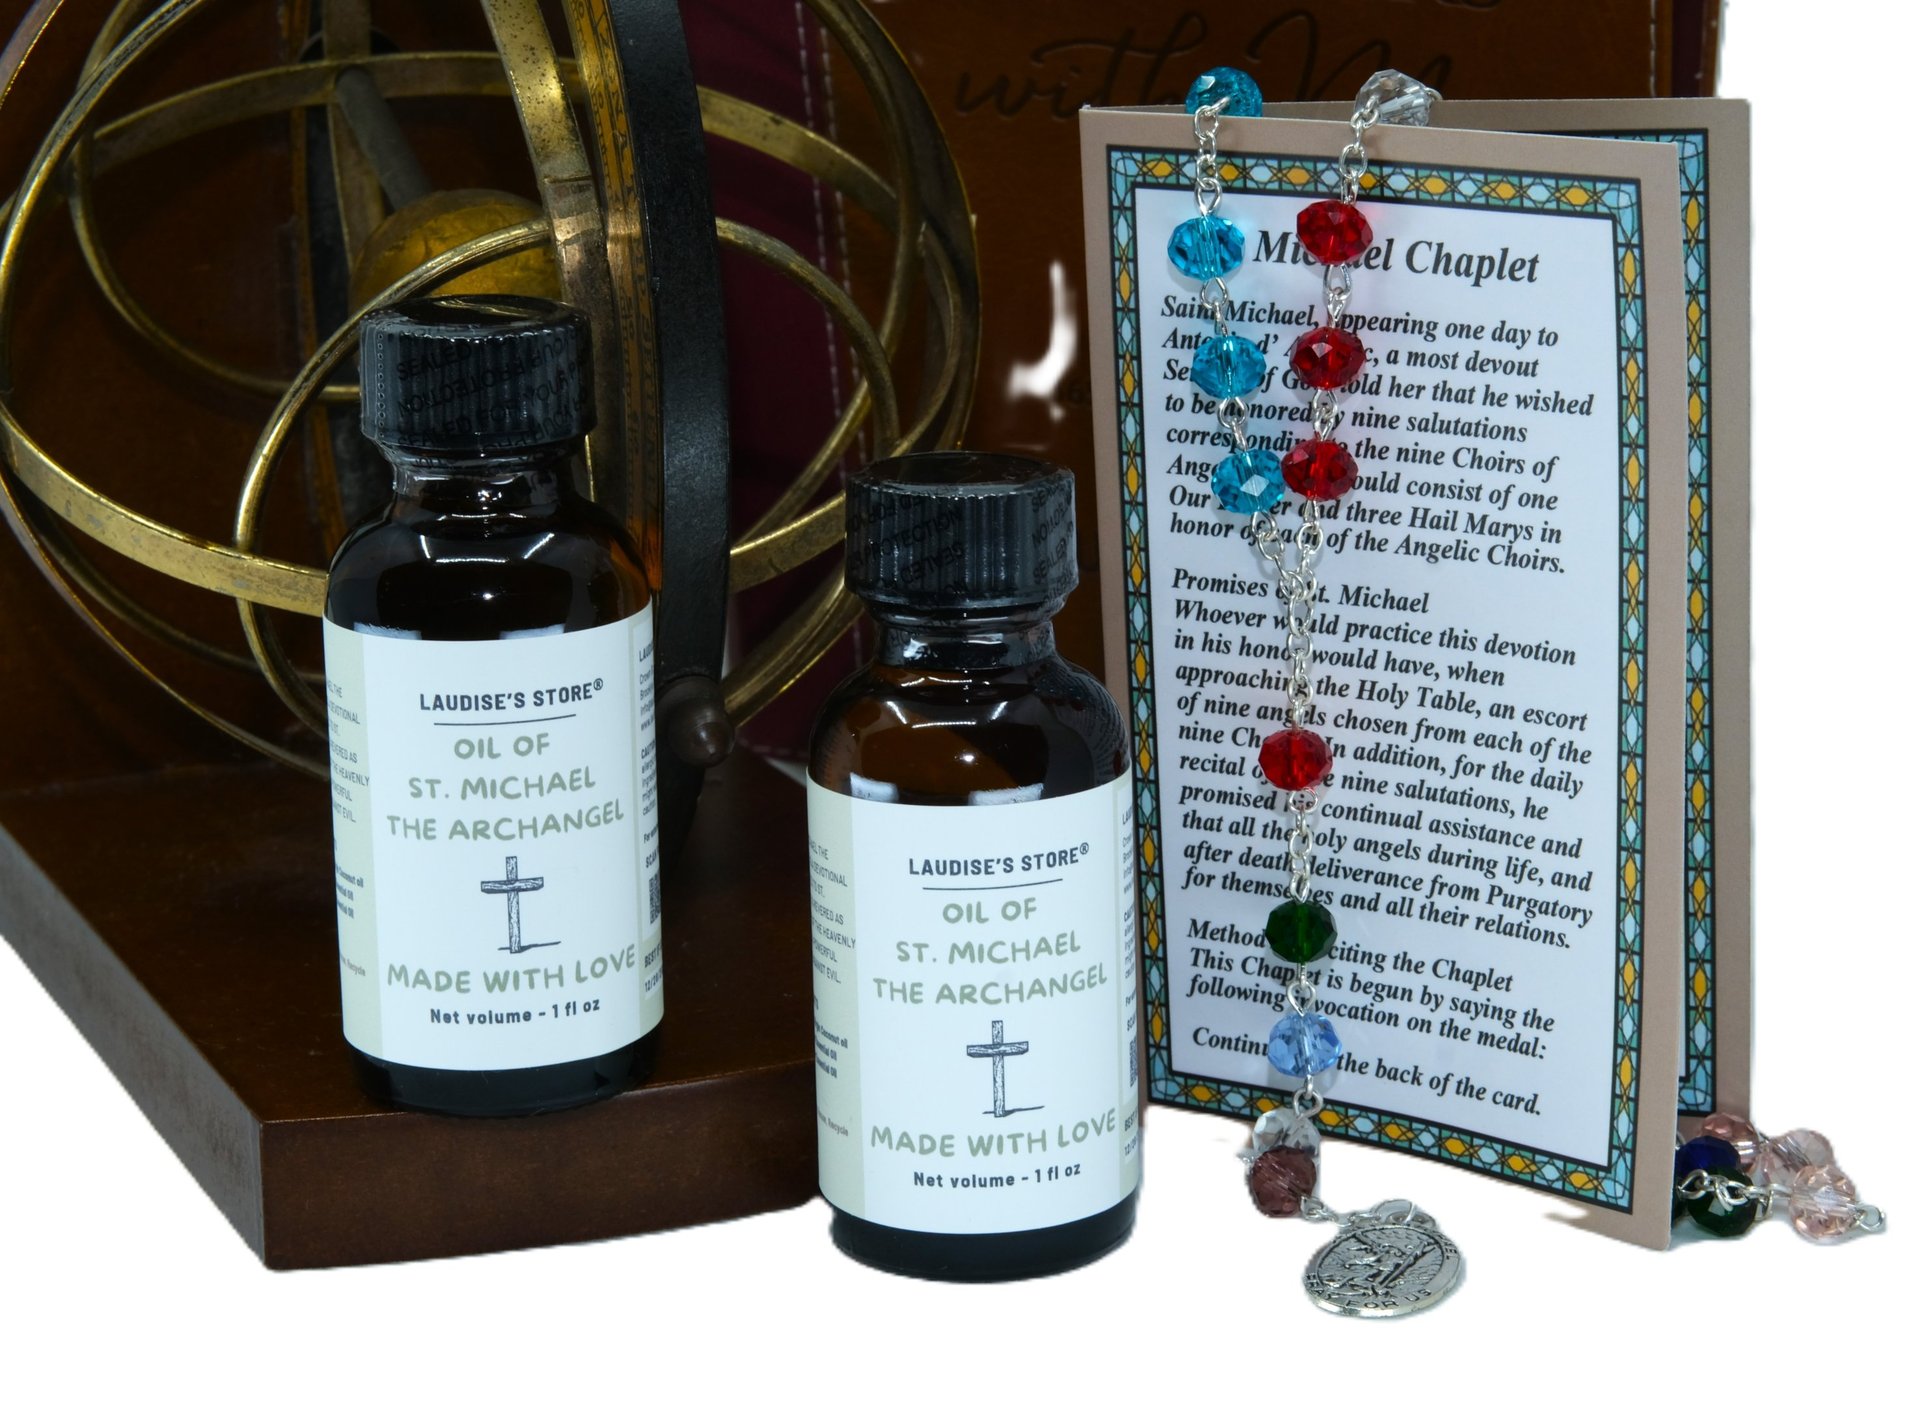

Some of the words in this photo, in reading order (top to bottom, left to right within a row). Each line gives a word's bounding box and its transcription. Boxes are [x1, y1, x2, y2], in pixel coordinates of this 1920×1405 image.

[1406, 241, 1539, 287] Chaplet
[1224, 301, 1319, 329] Michael,
[1445, 323, 1485, 340] one
[1491, 320, 1531, 350] day
[1538, 327, 1558, 346] to
[1386, 350, 1399, 364] a
[1407, 351, 1459, 370] most
[1465, 350, 1539, 377] devout
[1165, 394, 1184, 412] to
[1191, 392, 1217, 415] be
[1351, 406, 1400, 429] nine
[1406, 412, 1527, 442] salutations
[1388, 376, 1426, 399] her
[1432, 380, 1476, 404] that
[1482, 384, 1508, 407] he
[1515, 389, 1594, 416] wished
[1355, 438, 1389, 460] the
[1396, 442, 1445, 465] nine
[1453, 447, 1525, 474] Choirs
[1533, 456, 1559, 483] of
[1169, 485, 1211, 508] Our
[1346, 501, 1402, 525] three
[1408, 507, 1458, 531] Hail
[1463, 512, 1533, 544] Marys
[1541, 521, 1561, 543] in
[1406, 479, 1482, 502] consist
[1489, 484, 1516, 511] of
[1518, 493, 1558, 510] one
[1170, 512, 1234, 538] honor
[1327, 528, 1352, 554] of
[1355, 530, 1388, 552] the
[1394, 534, 1479, 564] Angelic
[1487, 544, 1564, 573] Choirs.
[1172, 568, 1268, 597] Promises
[1338, 584, 1429, 613] Michael
[1176, 599, 1267, 627] Whoever
[1343, 622, 1432, 645] practice
[1439, 628, 1477, 651] this
[1484, 633, 1575, 665] devotion
[1175, 629, 1194, 650] in
[1202, 632, 1231, 654] his
[1312, 648, 1378, 669] would
[1384, 651, 1439, 681] have,
[1448, 661, 1504, 686] when
[1177, 692, 1201, 716] of
[1205, 695, 1250, 717] nine
[1333, 709, 1407, 736] chosen
[1411, 718, 1465, 744] from
[1473, 731, 1522, 753] each
[1530, 737, 1556, 763] of
[1558, 741, 1592, 764] the
[1316, 676, 1350, 697] the
[1356, 680, 1408, 709] Holy
[1417, 687, 1481, 719] Table,
[1489, 703, 1515, 720] an
[1523, 708, 1587, 731] escort
[454, 737, 501, 759] OIL
[513, 733, 550, 757] OF
[1179, 721, 1224, 744] nine
[1353, 742, 1446, 776] addition,
[1450, 754, 1485, 779] for
[1492, 761, 1524, 784] the
[1531, 767, 1583, 799] daily
[409, 777, 449, 799] ST.
[461, 766, 596, 800] MICHAEL
[1180, 753, 1245, 776] recital
[1341, 771, 1388, 794] nine
[1394, 779, 1515, 822] salutations,
[1523, 797, 1548, 820] he
[387, 815, 436, 840] THE
[449, 798, 624, 841] ARCHANGEL
[1179, 786, 1278, 810] promised
[1321, 803, 1422, 830] continual
[1429, 818, 1535, 853] assistance
[1541, 838, 1582, 859] and
[1183, 810, 1223, 832] that
[1229, 816, 1255, 837] all
[1262, 820, 1293, 842] the
[1353, 838, 1421, 861] angels
[1428, 844, 1498, 879] during
[1505, 856, 1543, 886] life,
[1551, 871, 1593, 891] and
[943, 901, 989, 924] OIL
[1001, 897, 1036, 921] OF
[1181, 866, 1216, 889] for
[1340, 892, 1381, 912] and
[1386, 897, 1414, 917] all
[1419, 901, 1469, 927] their
[1475, 914, 1569, 948] relations.
[1184, 840, 1233, 865] after
[1425, 875, 1479, 901] from
[1484, 884, 1592, 932] Purgatory
[823, 929, 856, 949] HEAVENLY
[896, 941, 936, 962] ST.
[948, 930, 1080, 964] MICHAEL
[1187, 918, 1266, 949] Method
[1393, 951, 1425, 974] the
[1432, 959, 1513, 992] Chaplet
[388, 964, 470, 994] MADE
[483, 965, 564, 993] WITH
[576, 943, 635, 983] LOVE
[873, 978, 923, 1004] THE
[936, 962, 1107, 1005] ARCHANGEL
[1191, 947, 1233, 971] This
[1327, 969, 1343, 989] is
[1350, 972, 1412, 1002] begun
[1420, 985, 1444, 1012] by
[1450, 997, 1517, 1029] saying
[1523, 1008, 1554, 1032] the
[431, 1009, 459, 1024] Net
[467, 1010, 531, 1024] volume
[552, 1004, 558, 1018] 1
[565, 1001, 576, 1016] fl
[583, 999, 599, 1012] oz
[1186, 974, 1288, 1013] following
[1407, 1017, 1431, 1033] on
[1439, 1018, 1471, 1041] the
[1477, 1031, 1546, 1059] medal:
[1336, 1052, 1369, 1075] the
[1375, 1058, 1423, 1086] back
[1429, 1073, 1454, 1096] of
[1456, 1077, 1486, 1100] the
[1492, 1091, 1540, 1115] card.
[871, 1126, 954, 1157] MADE
[968, 1129, 1046, 1157] WITH
[1058, 1107, 1115, 1148] LOVE
[914, 1172, 943, 1187] Net
[951, 1174, 1014, 1188] volume
[1035, 1169, 1040, 1183] 1
[1048, 1166, 1058, 1181] fl
[1065, 1164, 1080, 1176] oz
[1406, 1289, 1432, 1302] US
